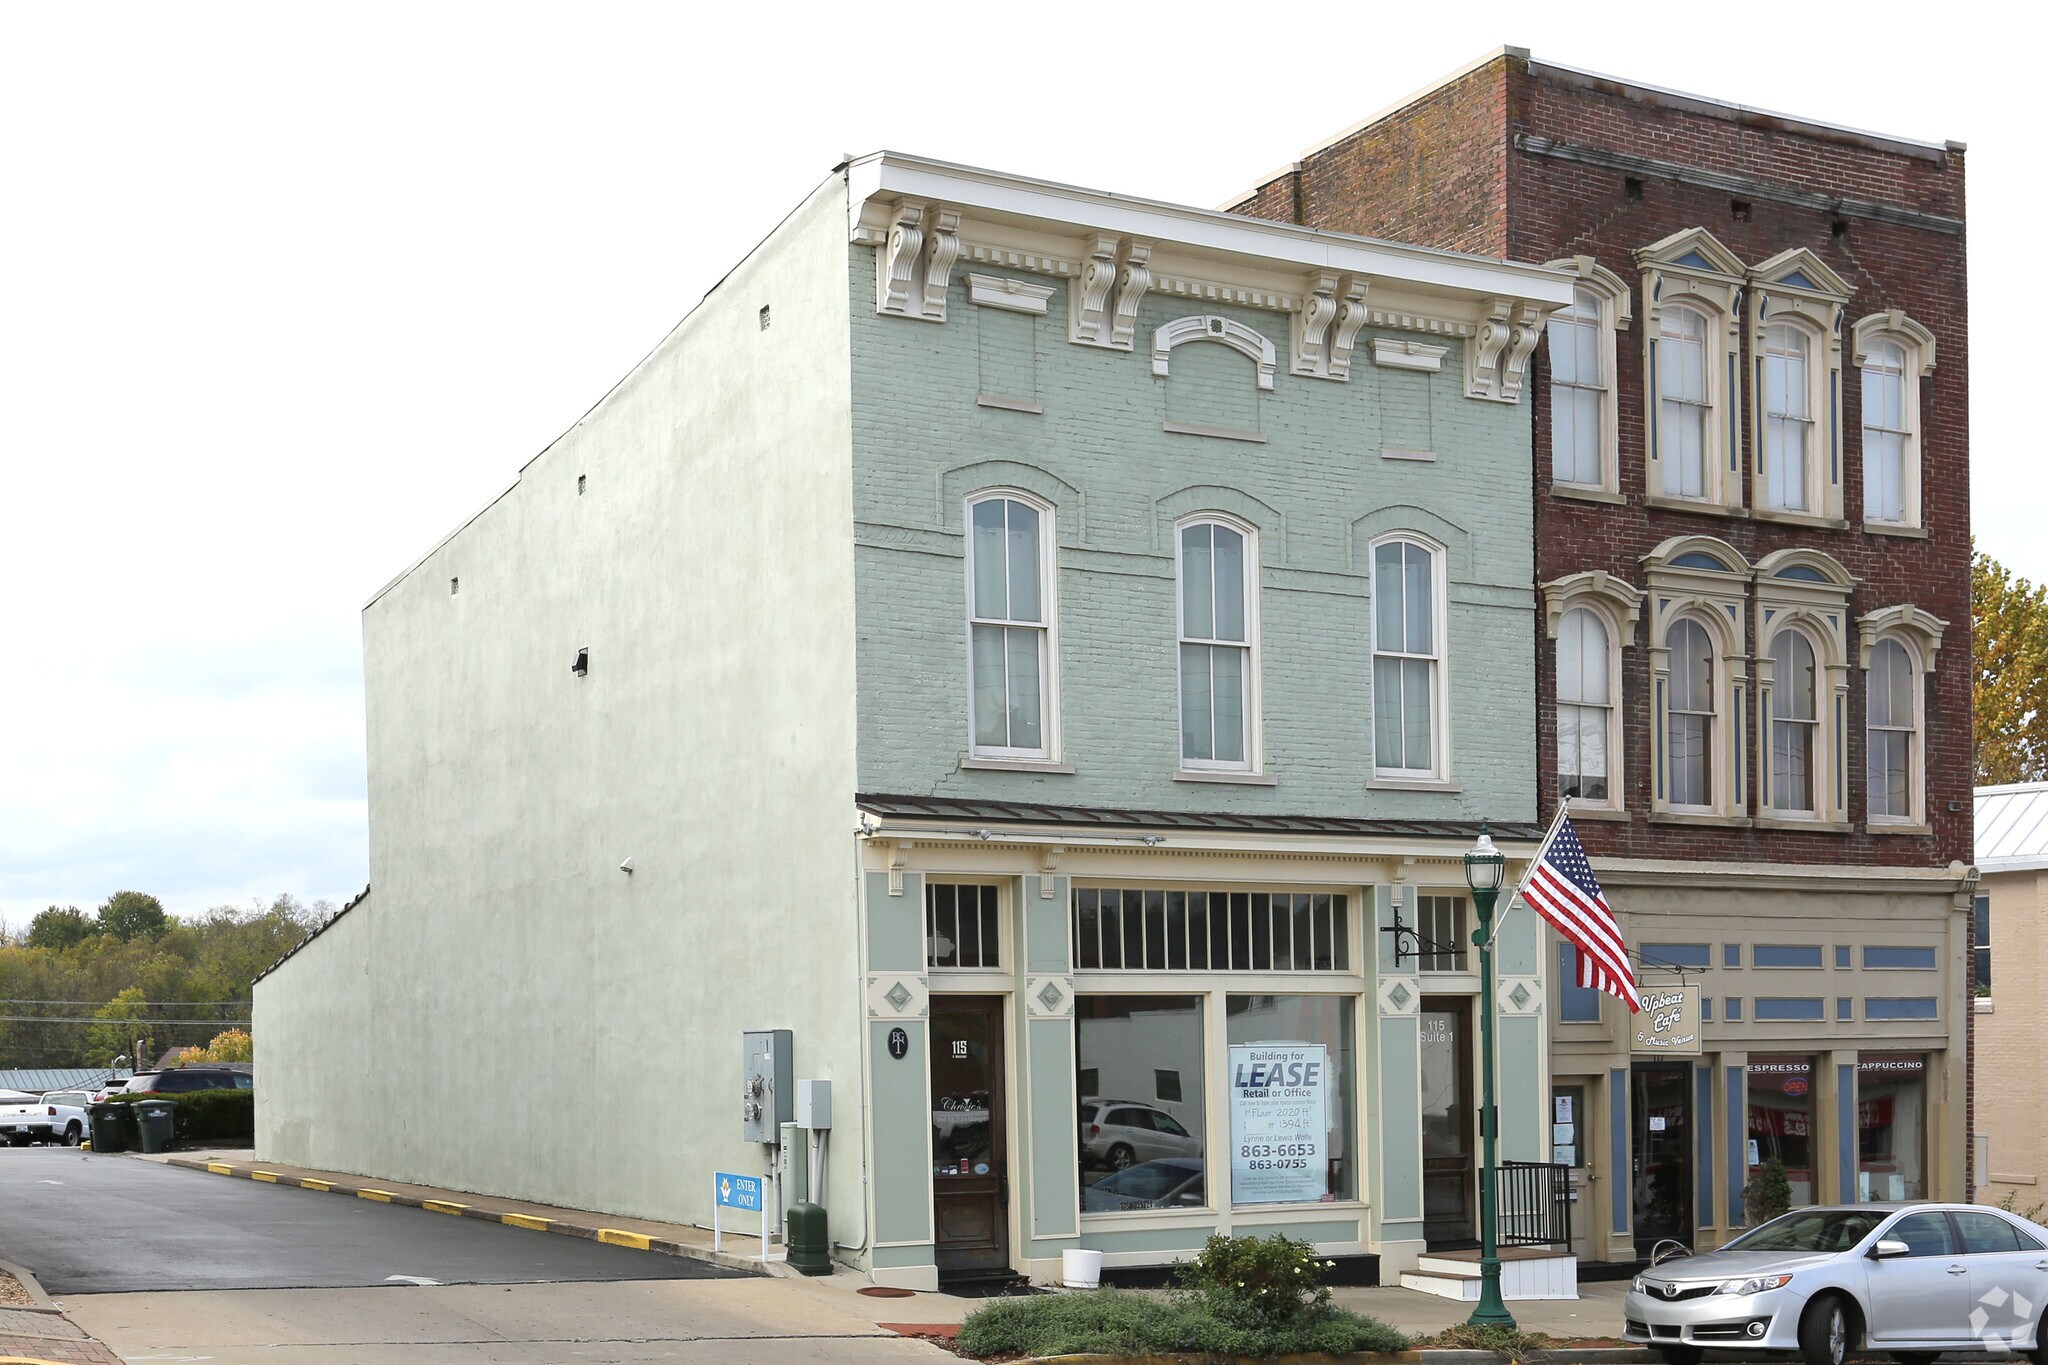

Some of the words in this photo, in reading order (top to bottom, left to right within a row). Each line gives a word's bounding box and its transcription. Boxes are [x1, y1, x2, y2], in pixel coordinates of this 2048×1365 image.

[1641, 992, 1684, 1018] Upbeat
[1428, 1020, 1445, 1031] 115
[1653, 1008, 1682, 1032] Café
[1420, 1031, 1445, 1042] Suite
[1448, 1031, 1454, 1042] 1
[1636, 1031, 1645, 1042] &
[1645, 1034, 1670, 1047] Music
[1671, 1034, 1695, 1046] Venue
[951, 1040, 968, 1055] 115
[1250, 1051, 1288, 1062] Building
[1290, 1051, 1305, 1060] for
[1747, 1064, 1810, 1072] ESPRESSO
[1234, 1062, 1321, 1088] LEASE
[1784, 1081, 1808, 1092] OPEN
[1243, 1088, 1269, 1098] Retail
[1271, 1090, 1281, 1098] or
[1284, 1088, 1312, 1097] Office
[1251, 1108, 1272, 1119] Floor
[1276, 1107, 1300, 1117] 2020
[1279, 1118, 1301, 1130] 1394
[1243, 1134, 1264, 1144] Lynne
[1274, 1133, 1293, 1142] Lewis
[1241, 1143, 1316, 1158] 863-6653
[1249, 1158, 1307, 1171] 863-0755
[736, 1178, 756, 1193] ENTER
[738, 1193, 755, 1208] ONLY
